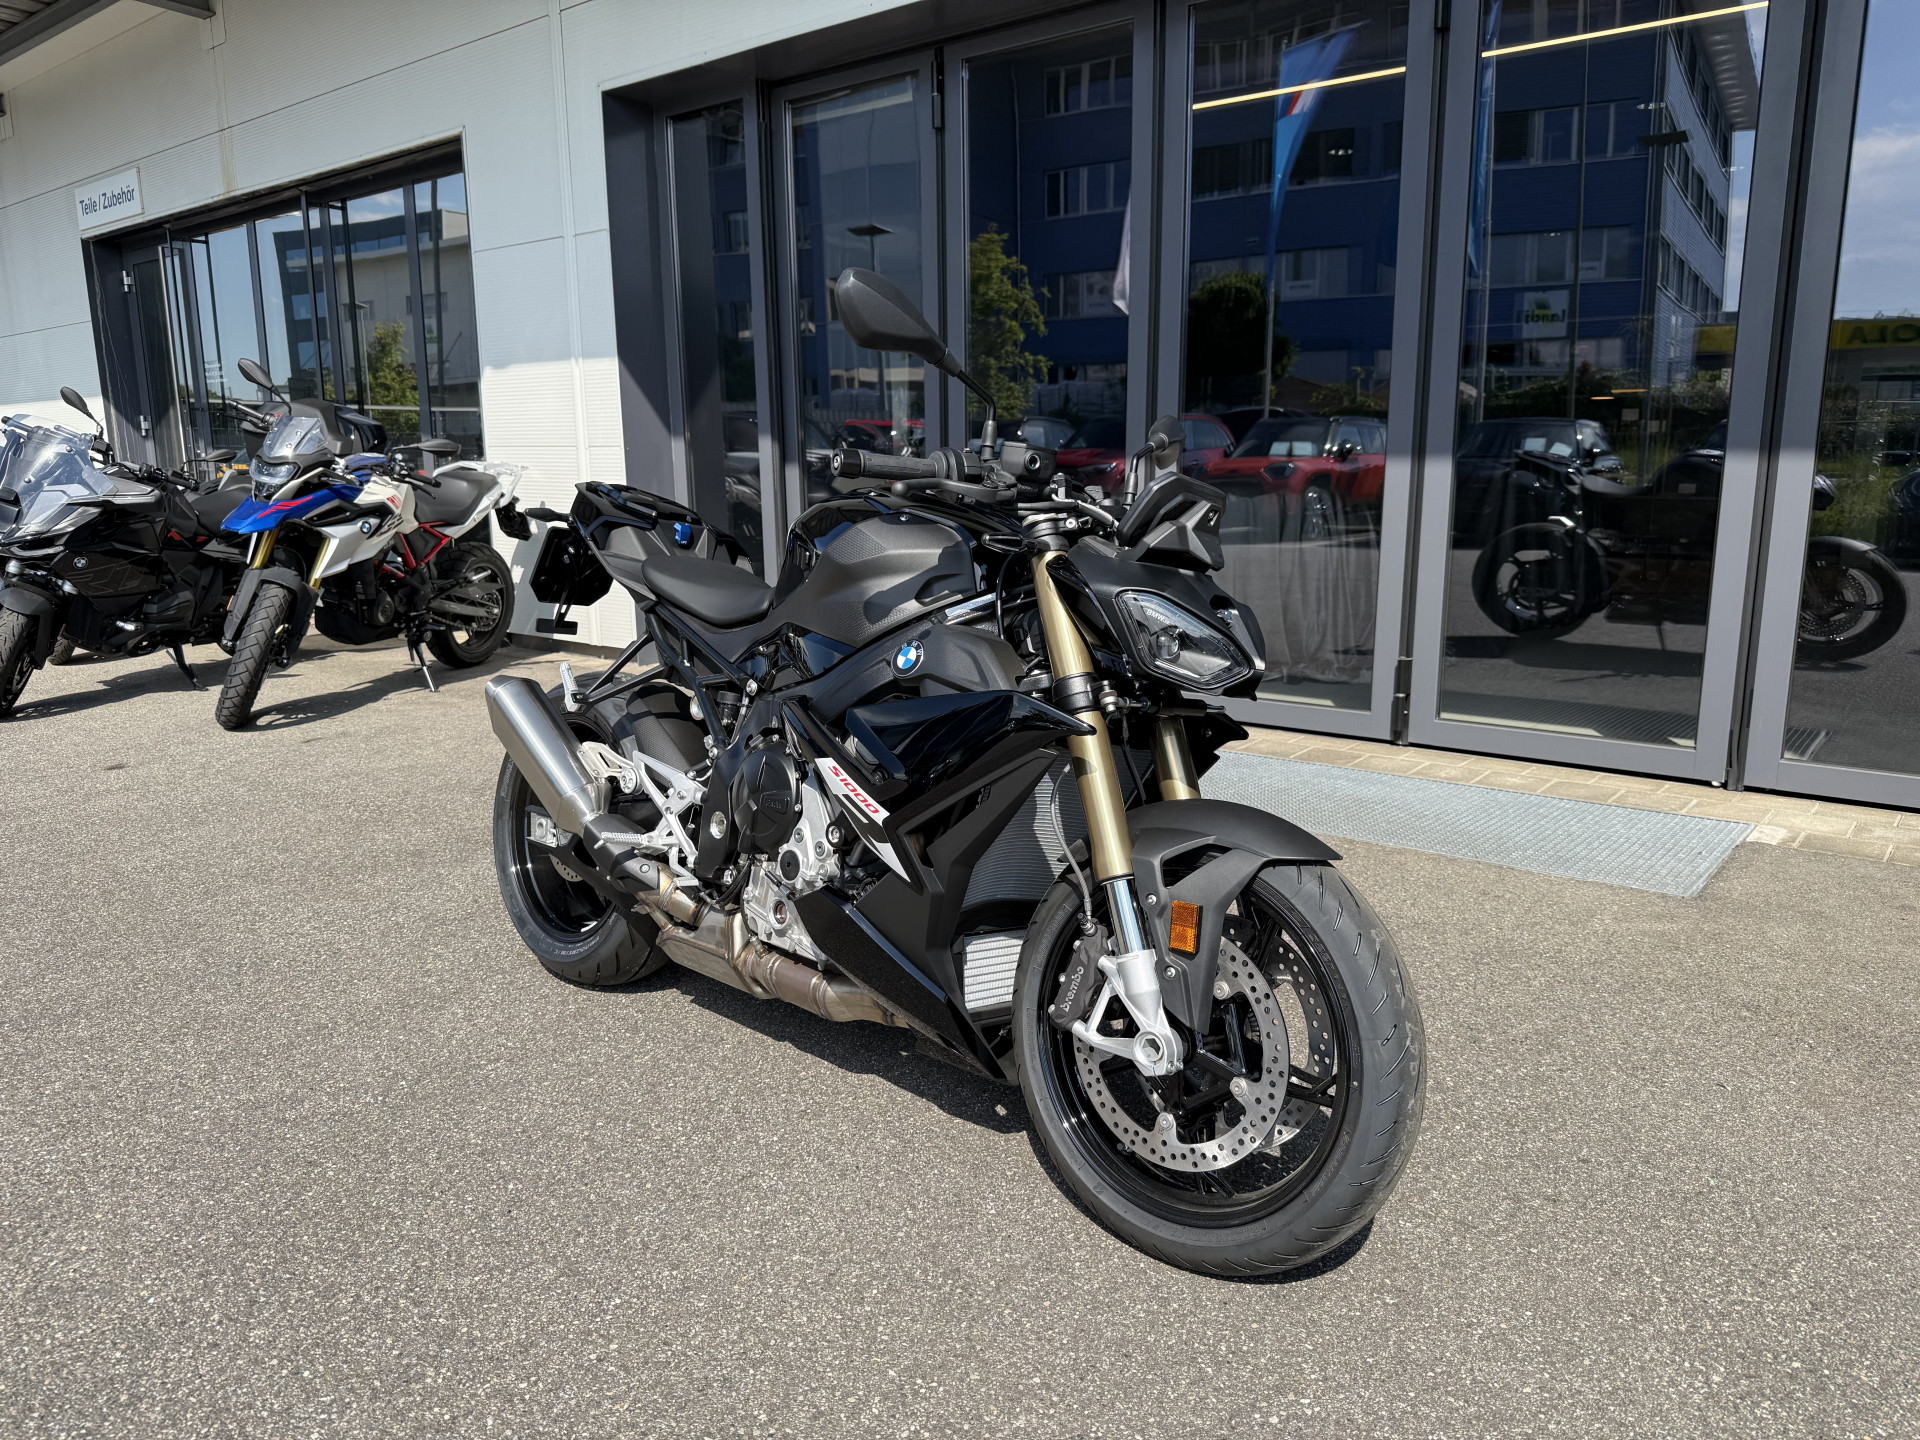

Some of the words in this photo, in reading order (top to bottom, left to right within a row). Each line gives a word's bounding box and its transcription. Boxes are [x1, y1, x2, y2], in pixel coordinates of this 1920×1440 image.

[901, 641, 922, 656] BMW
[828, 766, 880, 814] S1000
[1060, 966, 1084, 1013] brembo
